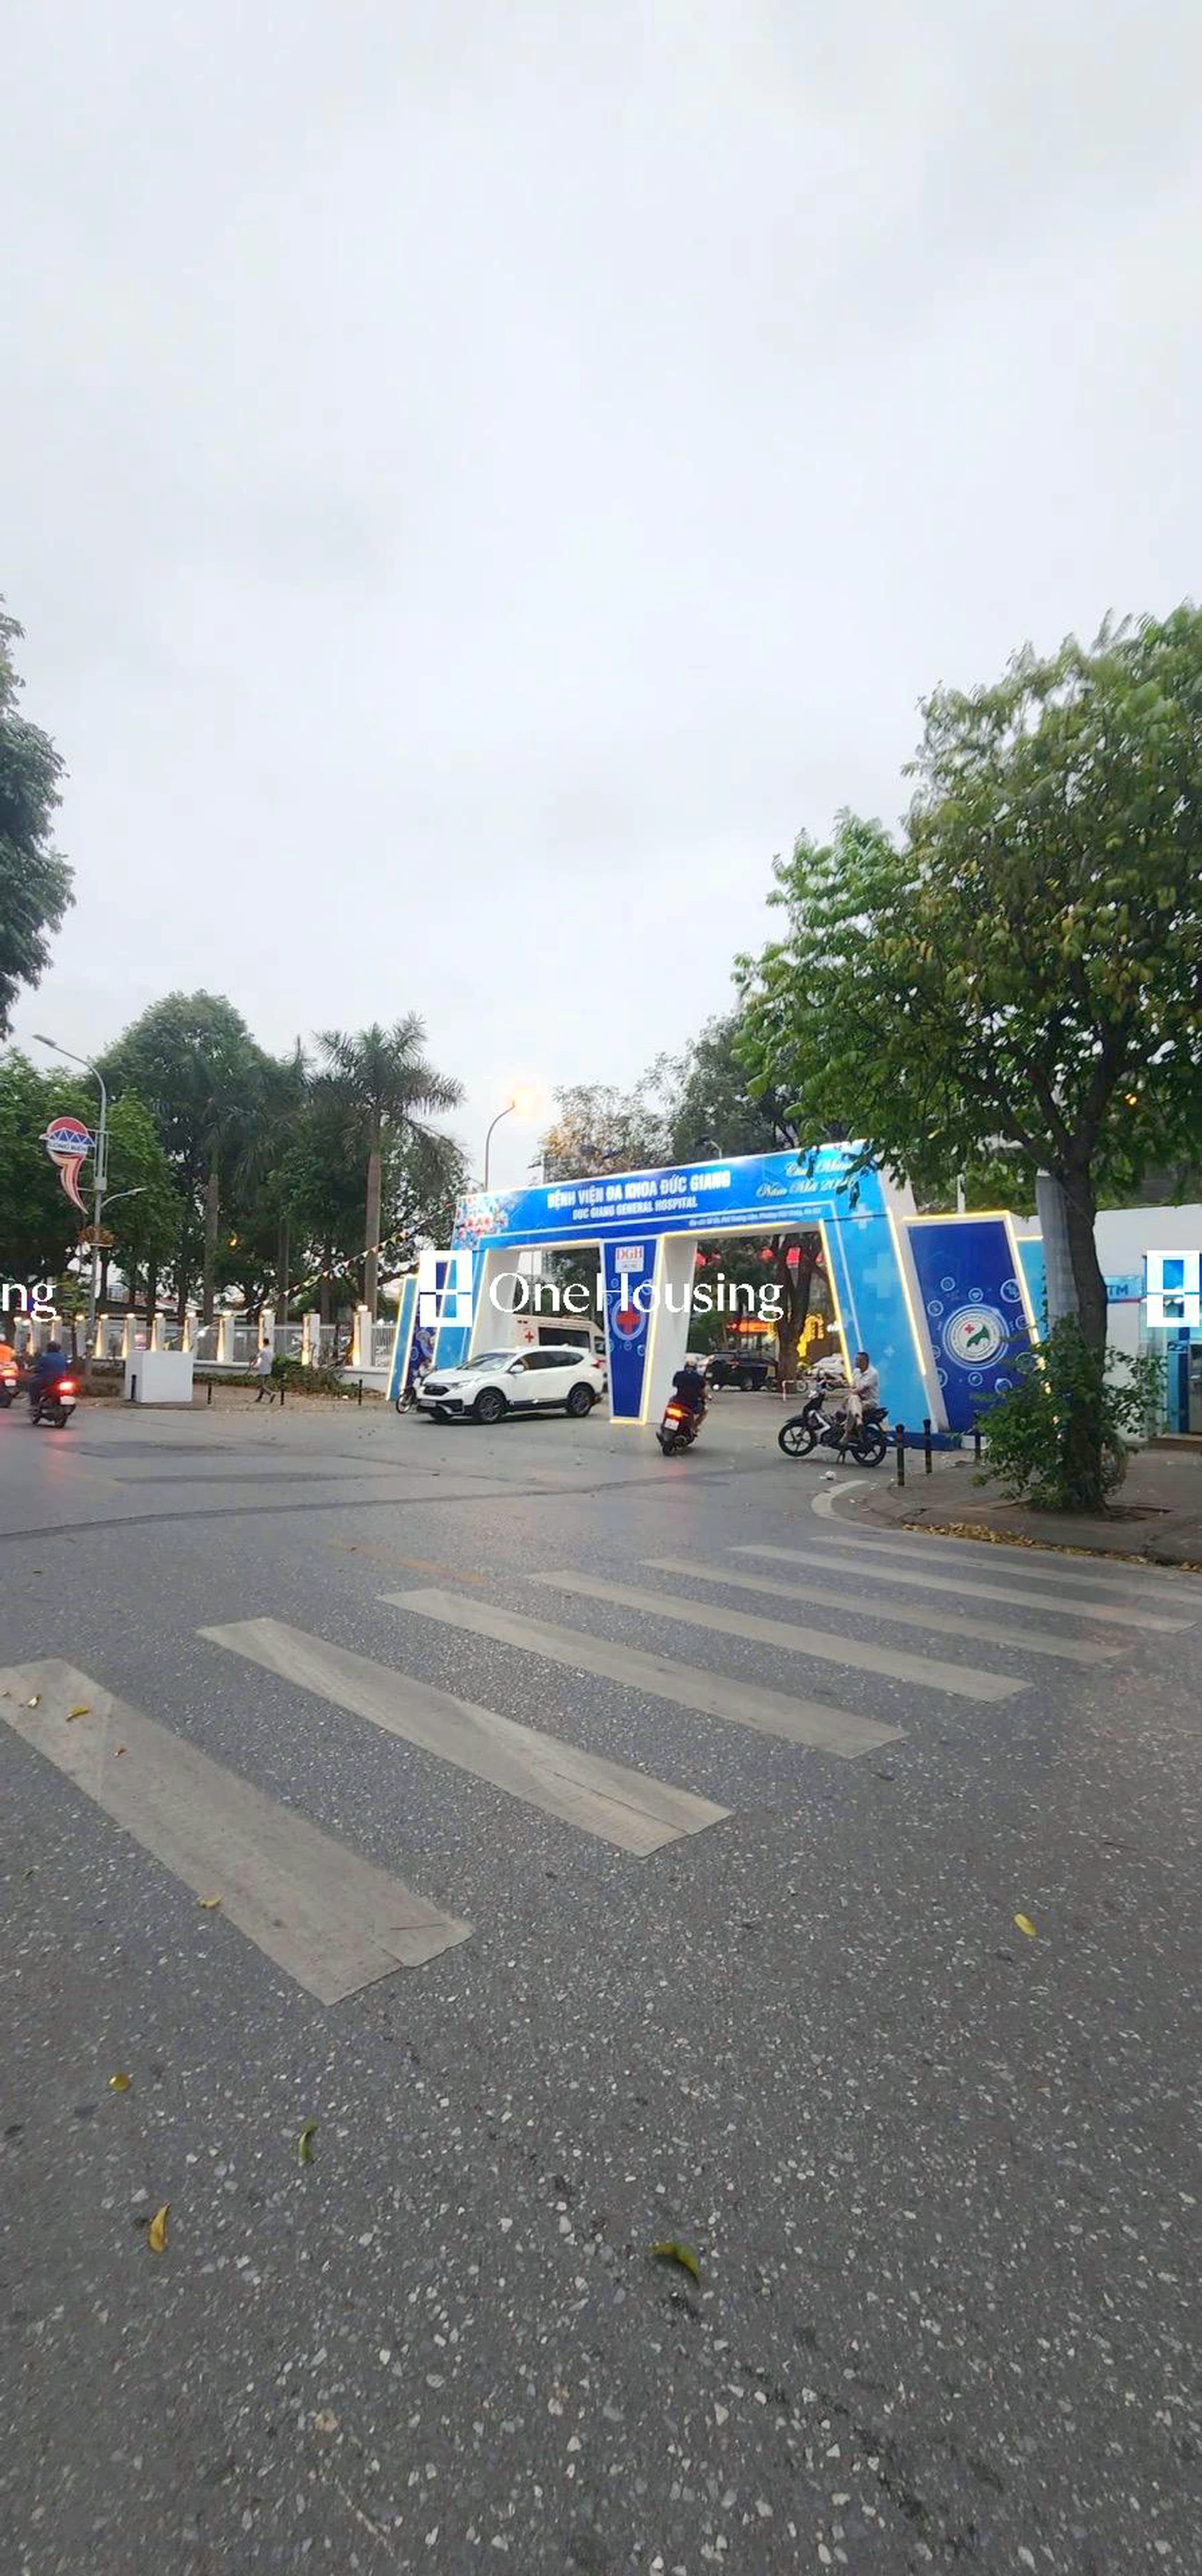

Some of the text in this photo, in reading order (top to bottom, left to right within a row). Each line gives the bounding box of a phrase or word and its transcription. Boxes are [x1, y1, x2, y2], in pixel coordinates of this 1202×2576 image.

[578, 1185, 604, 1207] VIỆN
[606, 1185, 622, 1201] ĐA
[625, 1180, 658, 1199] KHOA
[660, 1174, 687, 1195] ĐỨC
[690, 1170, 731, 1191] GIANG
[616, 1200, 653, 1216] GENERAL
[656, 1196, 698, 1212] HOSPITAL
[1105, 1285, 1129, 1296] TM
